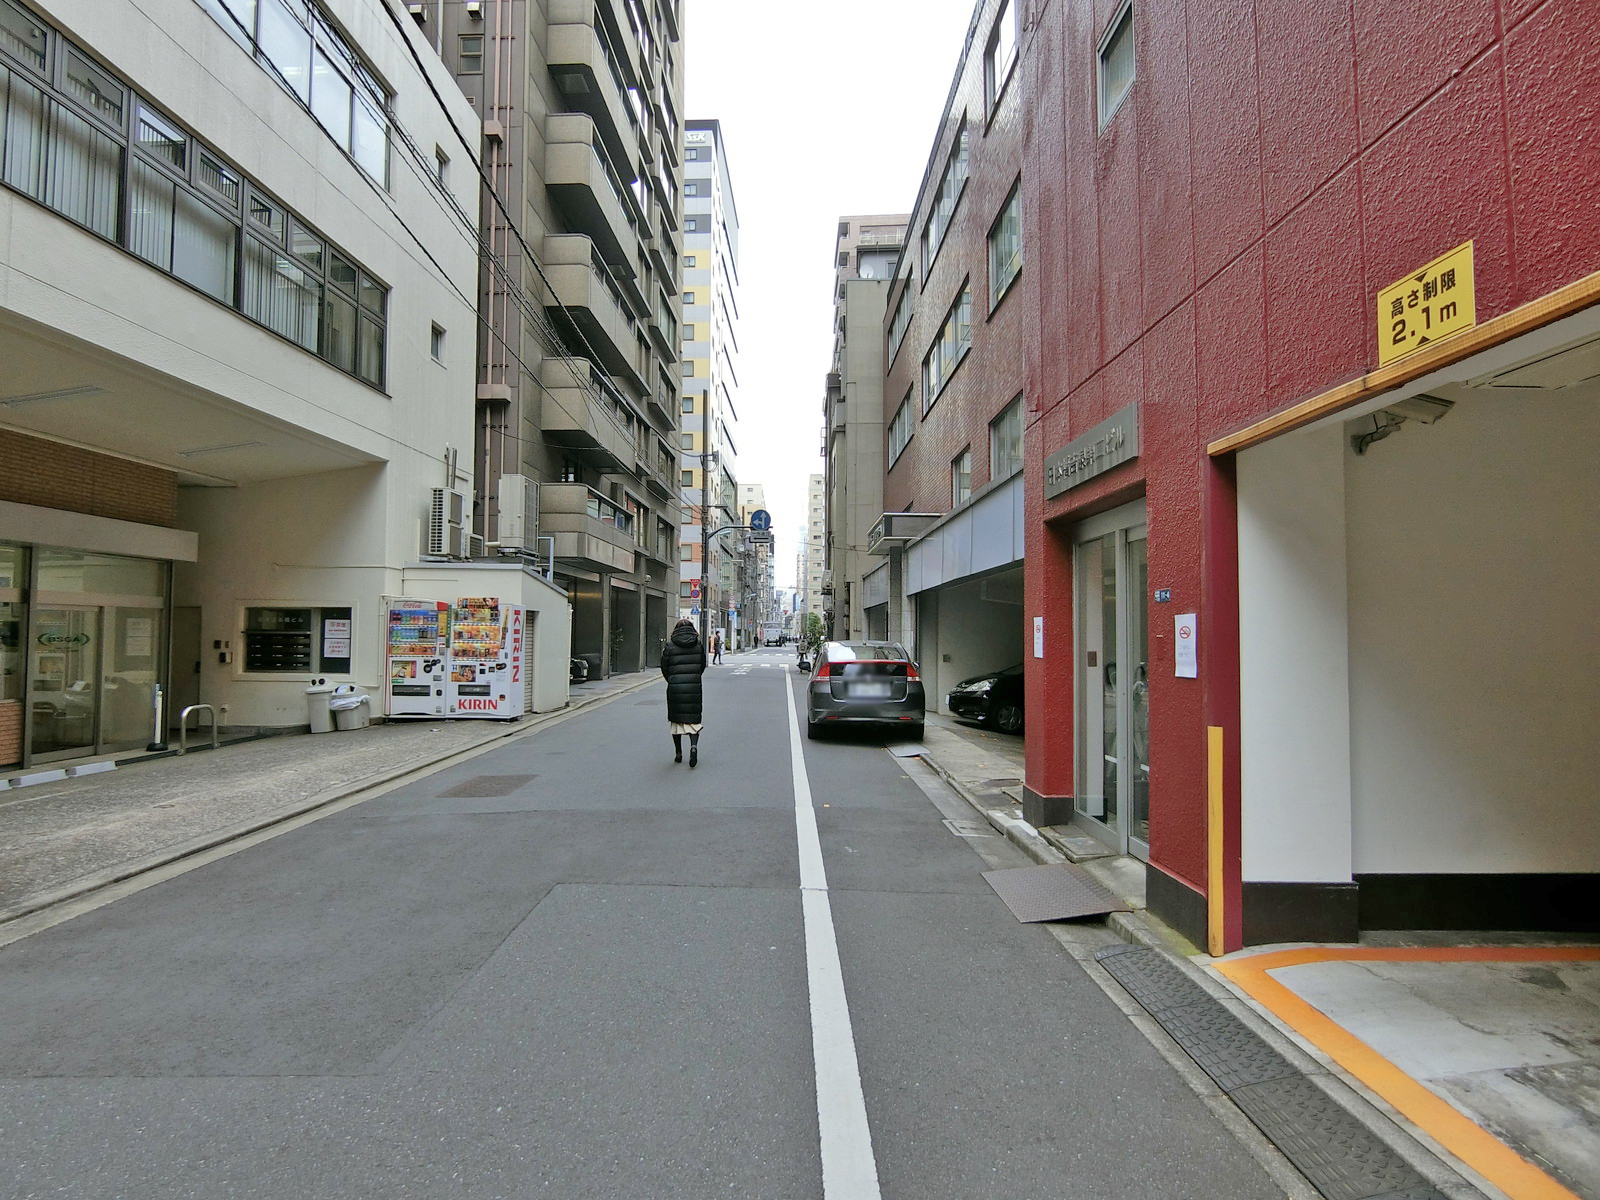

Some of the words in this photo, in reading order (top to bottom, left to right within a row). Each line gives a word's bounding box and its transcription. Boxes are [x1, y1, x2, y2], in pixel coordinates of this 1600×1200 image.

[1391, 268, 1456, 319] 高さ制限
[512, 610, 521, 682] KIRIN
[458, 699, 498, 710] KIRIN
